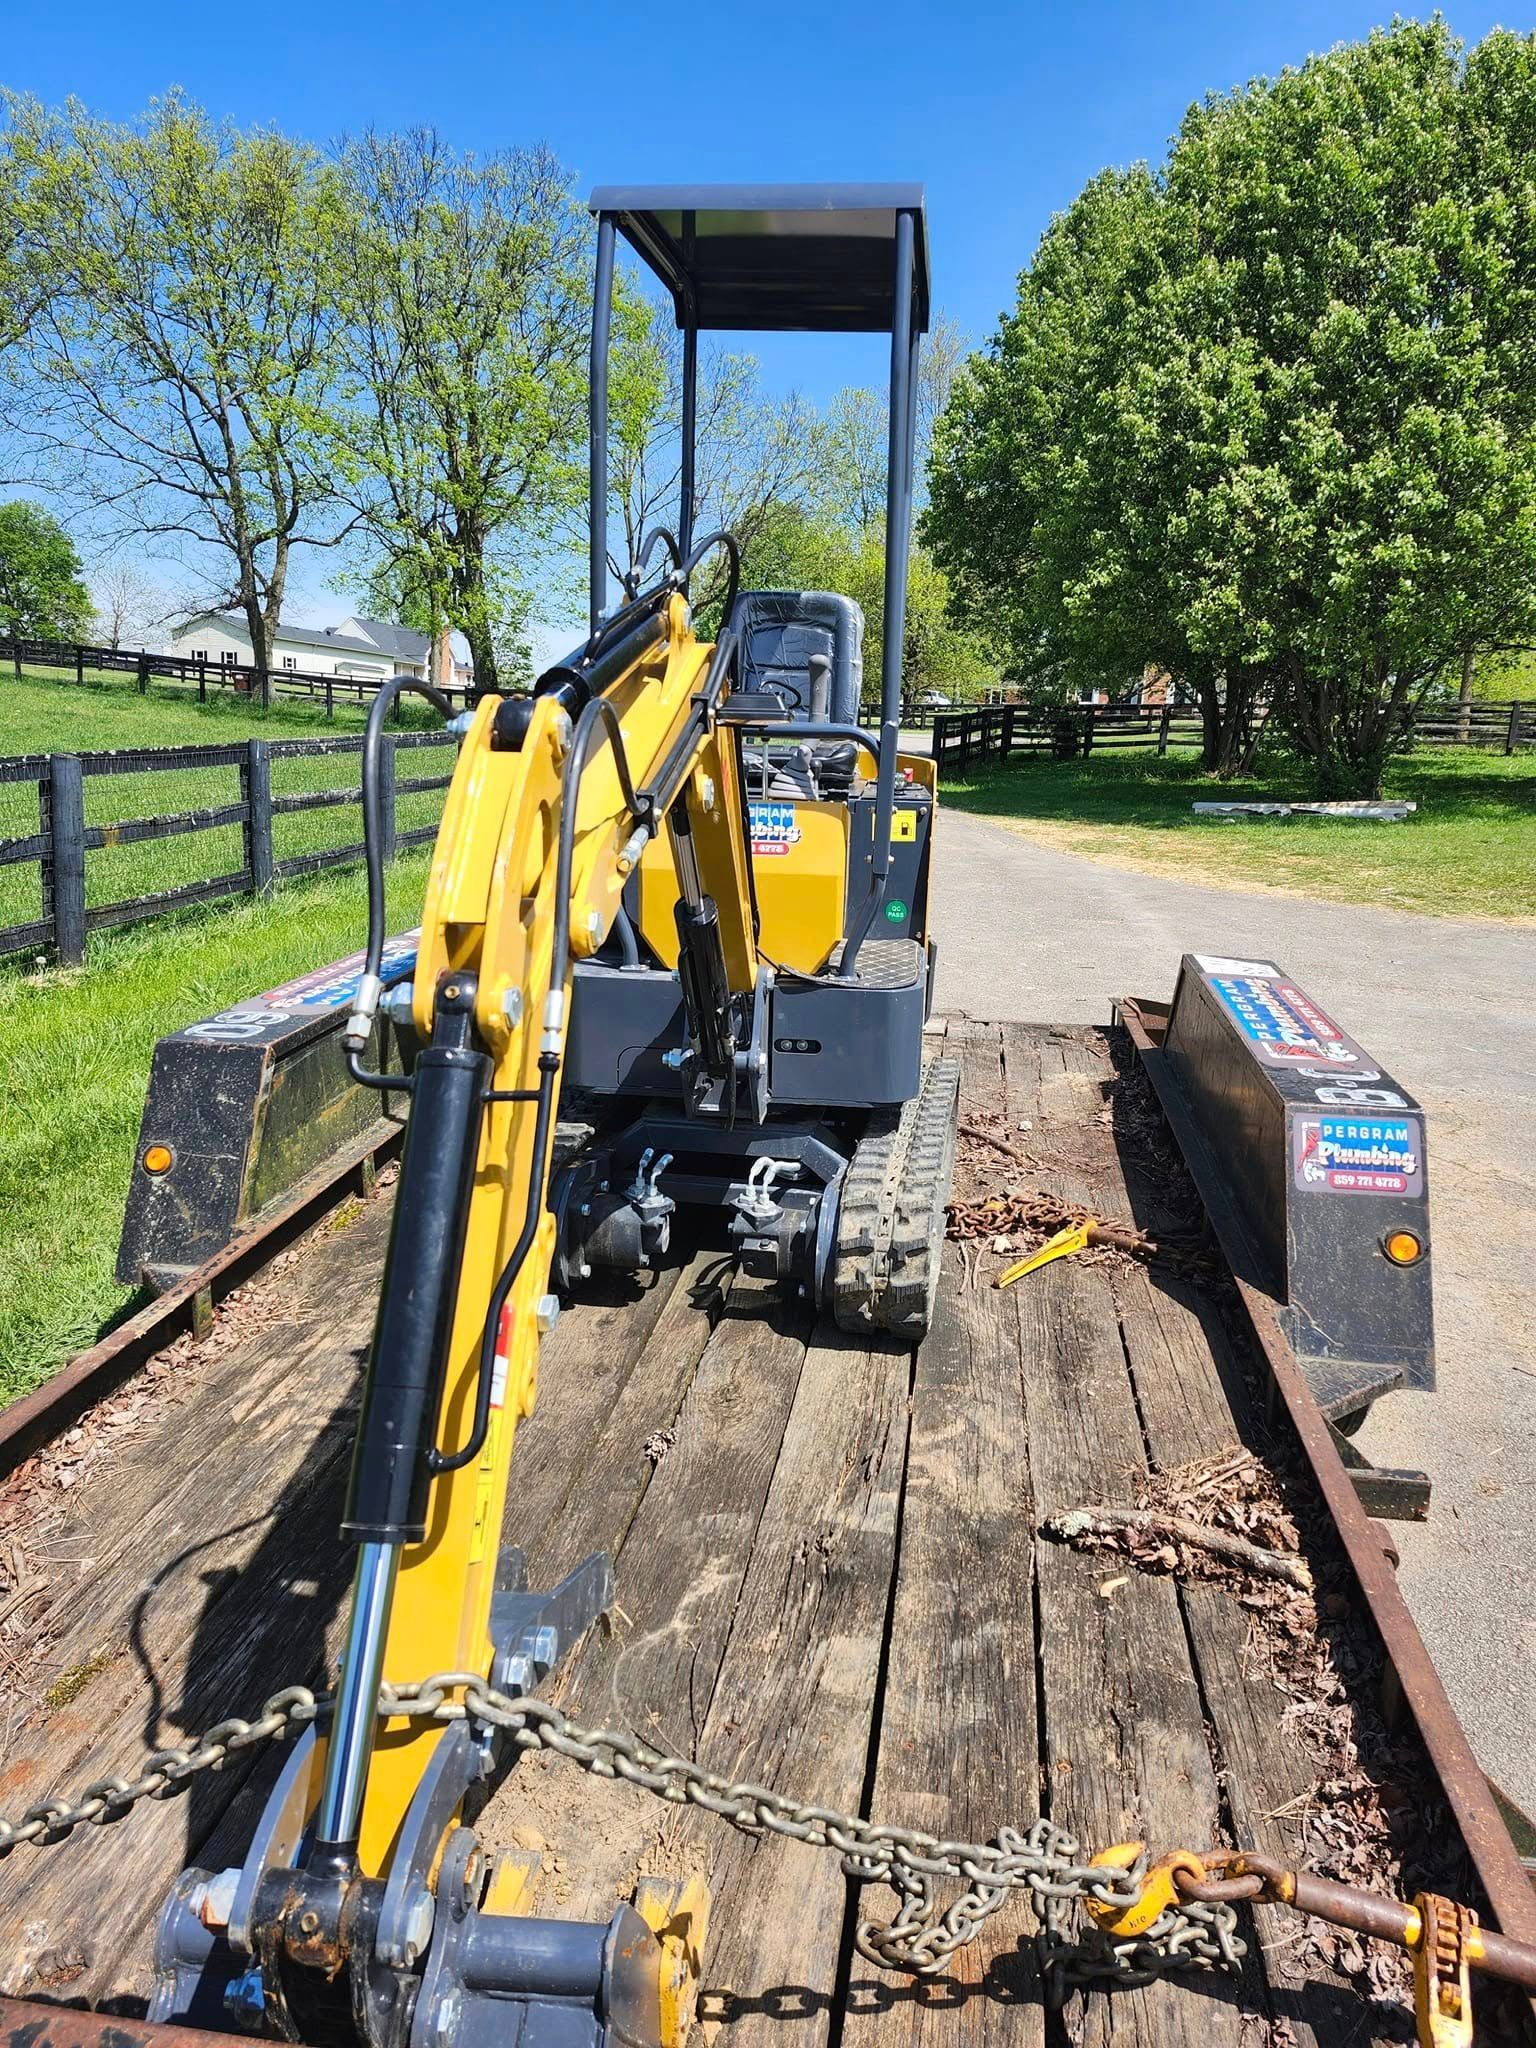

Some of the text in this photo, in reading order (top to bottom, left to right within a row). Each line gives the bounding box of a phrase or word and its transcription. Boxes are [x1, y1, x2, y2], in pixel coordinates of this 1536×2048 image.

[1218, 979, 1277, 1040] PERGRAM
[1244, 977, 1321, 1048] Plumbing
[1323, 1125, 1408, 1141] PERGRAM
[1317, 1141, 1419, 1175] Plumbing
[1334, 1174, 1401, 1188] 859 771 4778
